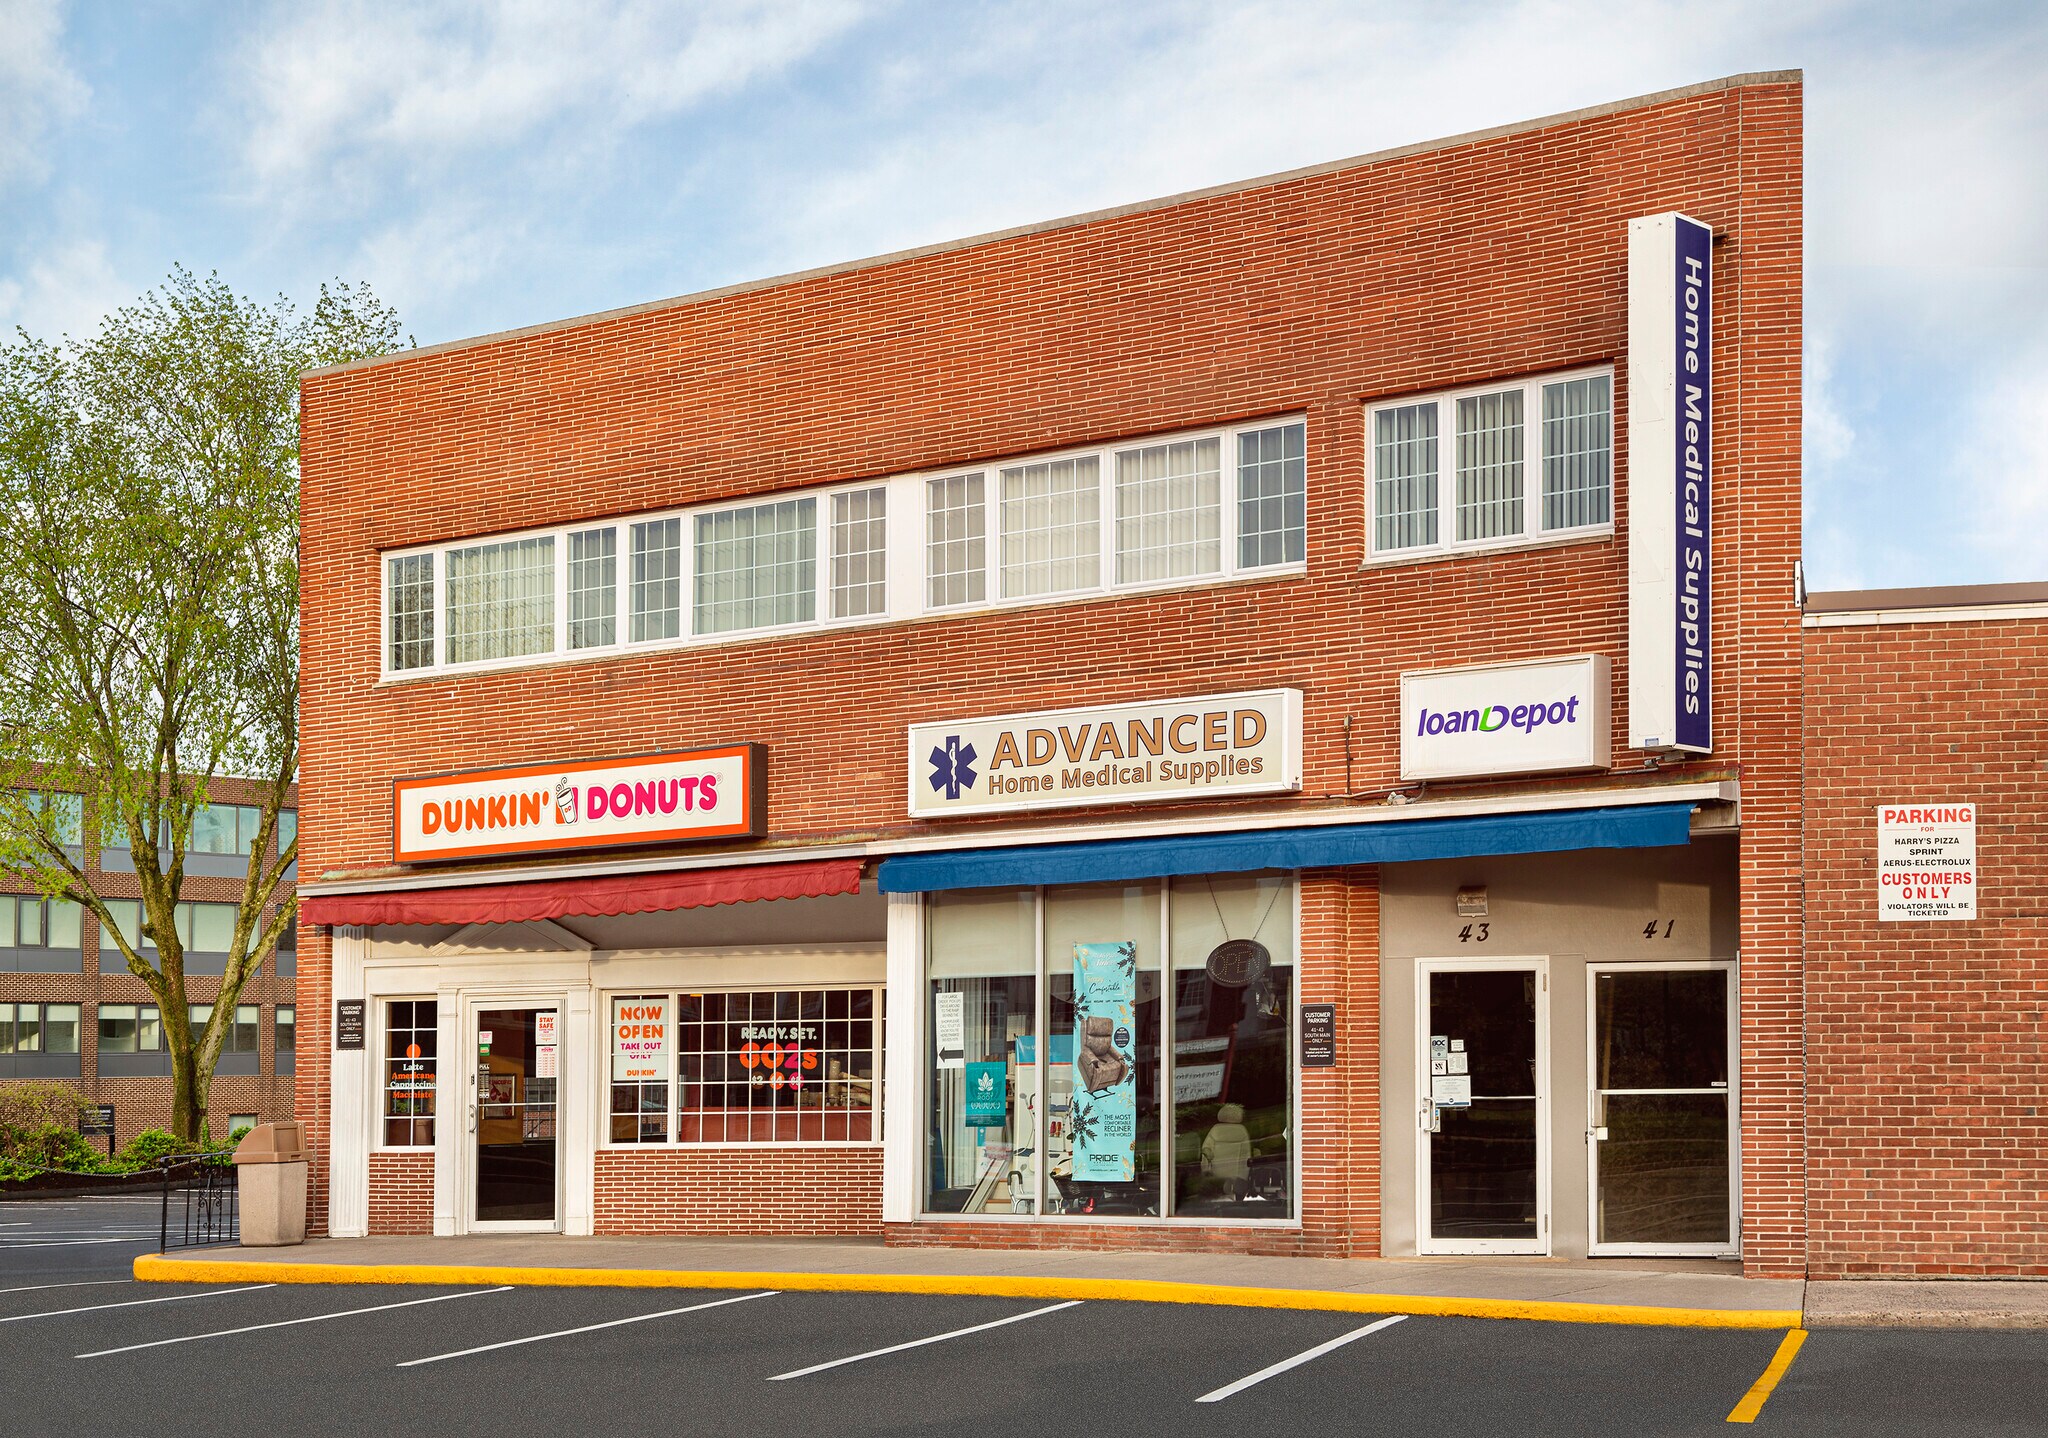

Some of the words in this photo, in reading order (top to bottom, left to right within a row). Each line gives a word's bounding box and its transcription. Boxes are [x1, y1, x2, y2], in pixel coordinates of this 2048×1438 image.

[1685, 256, 1702, 374] Home
[1685, 386, 1703, 537] Medical
[1680, 548, 1703, 714] Supplies
[1418, 695, 1579, 736] loanDepot
[990, 709, 1267, 770] ADVANCED
[989, 769, 1054, 795] Home
[1062, 762, 1152, 790] Medical
[1160, 756, 1264, 785] Supplies
[422, 791, 550, 834] DUNKIN'
[1884, 808, 1972, 824] PARKING
[1882, 872, 1972, 886] CUSTOMERS
[1902, 887, 1950, 899] ONLY
[1458, 922, 1490, 942] 43
[1643, 920, 1675, 938] 41
[621, 1006, 662, 1020] NOW
[619, 1025, 663, 1039] OPEN
[392, 1072, 435, 1080] Americano
